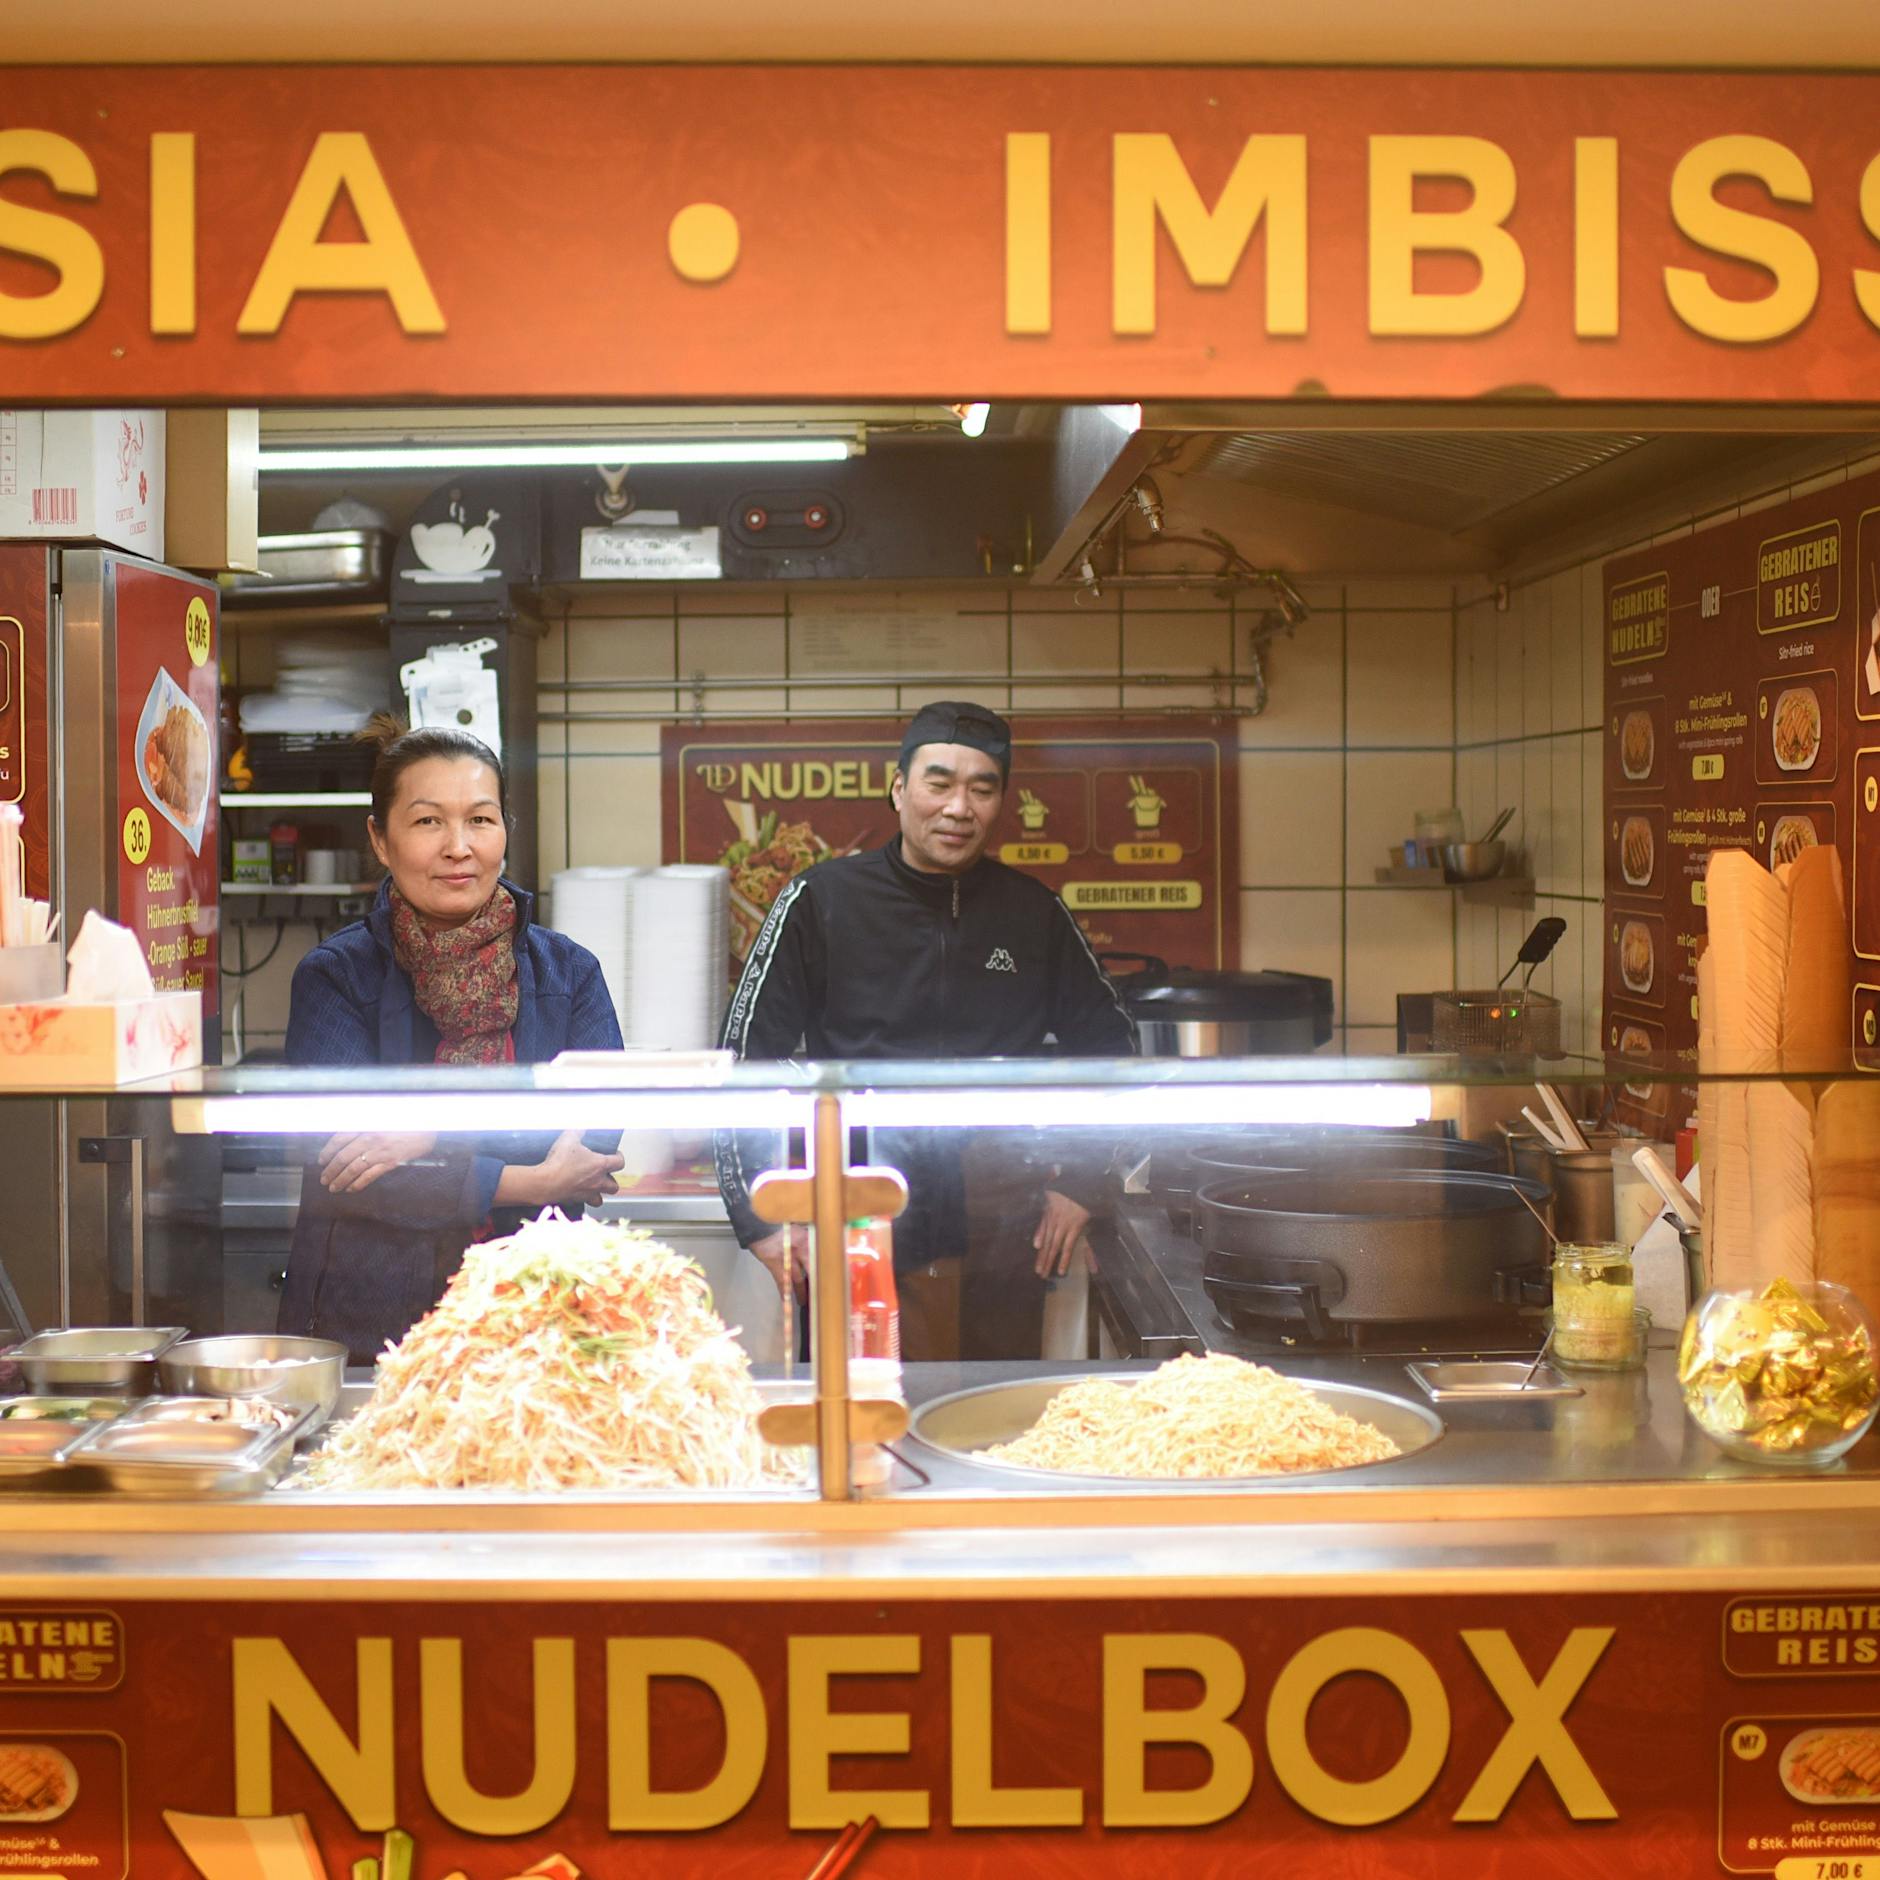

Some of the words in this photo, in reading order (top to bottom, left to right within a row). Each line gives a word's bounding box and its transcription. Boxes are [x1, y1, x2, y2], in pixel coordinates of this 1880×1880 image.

[0, 128, 448, 341] SIA
[1005, 132, 1880, 344] IMBIS
[591, 555, 623, 566] Keine
[1760, 536, 1838, 583] GEBRATENER
[1612, 585, 1666, 621] GEBRATENE
[1701, 585, 1720, 618] ODER
[1774, 584, 1809, 618] REIS
[1612, 619, 1654, 653] NUDELN
[1688, 697, 1699, 711] mit
[1690, 712, 1747, 732] Mini-Frühlingsrollen
[1673, 808, 1682, 822] mit
[1729, 807, 1746, 826] große
[131, 819, 147, 853] 36.
[1667, 829, 1707, 847] Frühlingsrollen
[147, 866, 176, 893] Geback.
[1076, 887, 1156, 904] GEBRATENER
[1160, 886, 1188, 902] REIS
[177, 935, 189, 962] Süß
[1777, 1637, 1878, 1666] REIS
[232, 1625, 1620, 1836] NUDELBOX
[1738, 1734, 1760, 1752] M7
[1791, 1820, 1815, 1833] mit
[1818, 1819, 1877, 1833] Gemüse
[49, 1837, 60, 1850] &
[1747, 1838, 1758, 1851] 8
[1760, 1837, 1788, 1850] Stk.
[1816, 1862, 1849, 1880] 7,00
[1854, 1863, 1863, 1879] €
